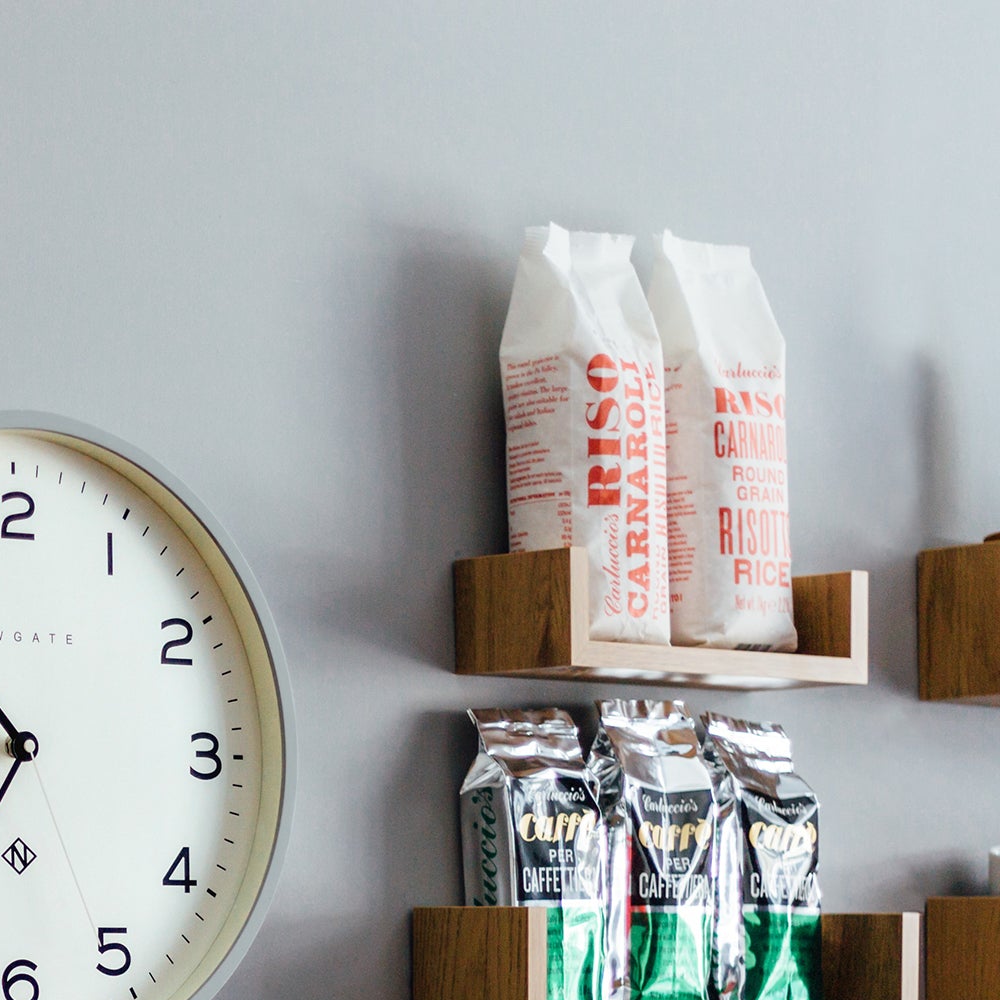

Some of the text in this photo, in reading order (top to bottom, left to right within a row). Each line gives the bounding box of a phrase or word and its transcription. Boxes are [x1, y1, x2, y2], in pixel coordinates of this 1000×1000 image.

[586, 353, 622, 508] RISO
[714, 420, 788, 464] CARNARO
[620, 358, 650, 618] CARNAROLI
[732, 465, 785, 486] ROUND
[736, 486, 784, 503] GRAIN
[106, 532, 114, 575] 1
[604, 512, 622, 617] Carluccio's
[734, 559, 790, 587] RICE
[160, 618, 193, 666] 2
[189, 733, 223, 780] 3
[162, 847, 198, 893] 4
[549, 849, 574, 862] PER
[522, 866, 600, 893] CAFFETTI
[96, 928, 131, 976] 5
